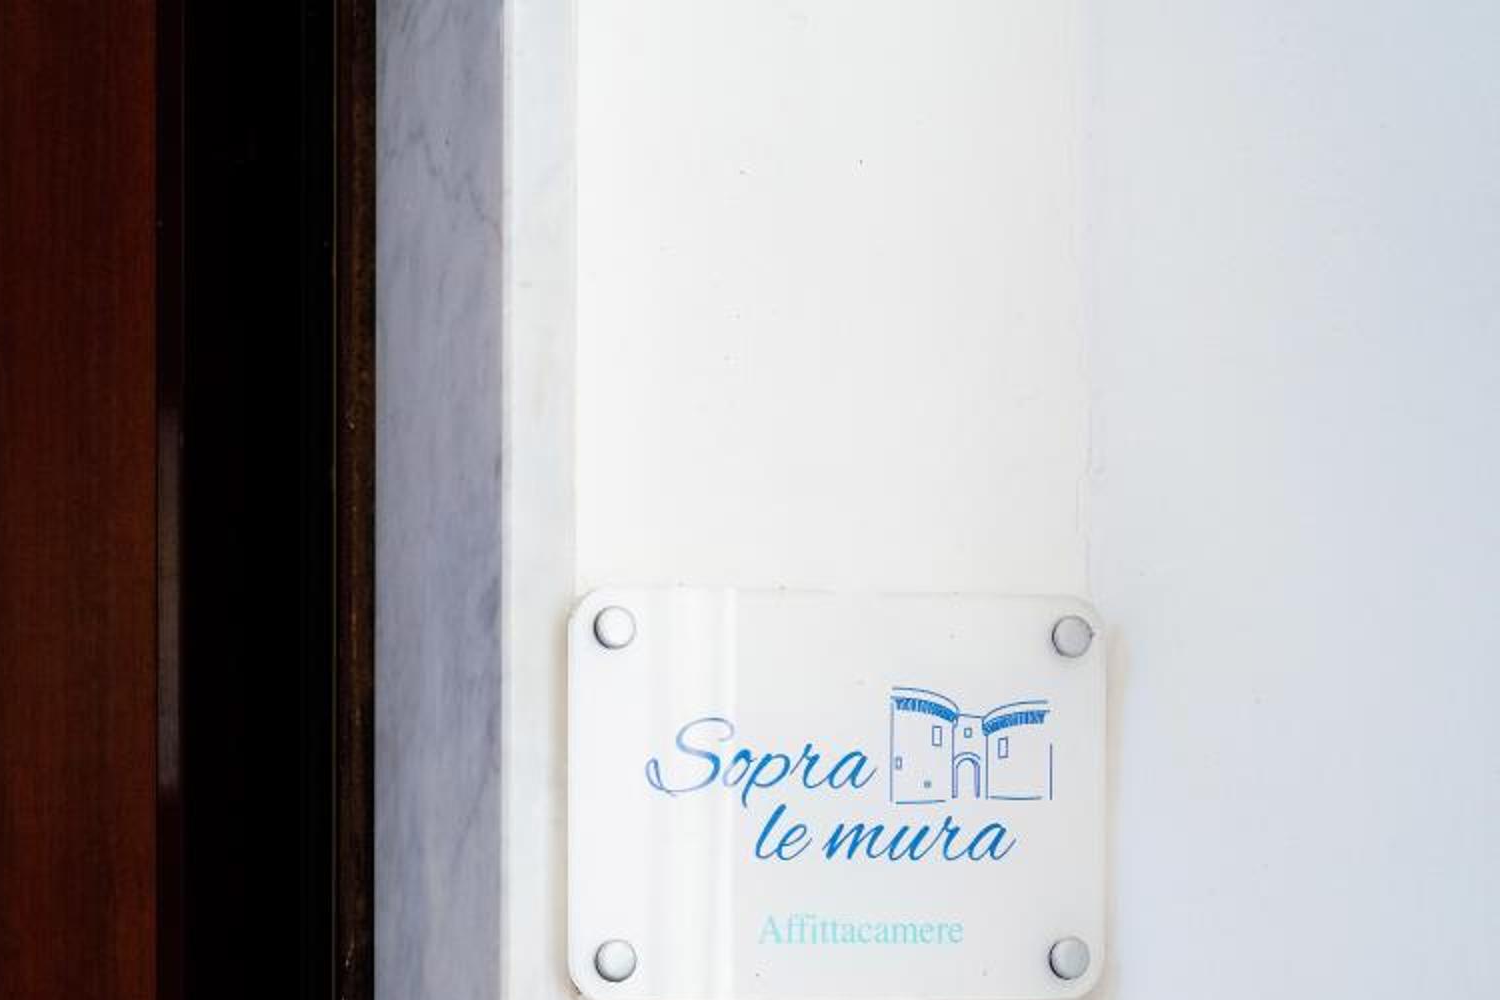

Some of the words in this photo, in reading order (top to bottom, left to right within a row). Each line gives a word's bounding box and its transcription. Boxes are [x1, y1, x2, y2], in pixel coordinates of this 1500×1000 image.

[645, 717, 877, 809] Sopra
[754, 803, 812, 861] le
[822, 815, 1017, 862] mura
[758, 914, 965, 945] Affittacamere
